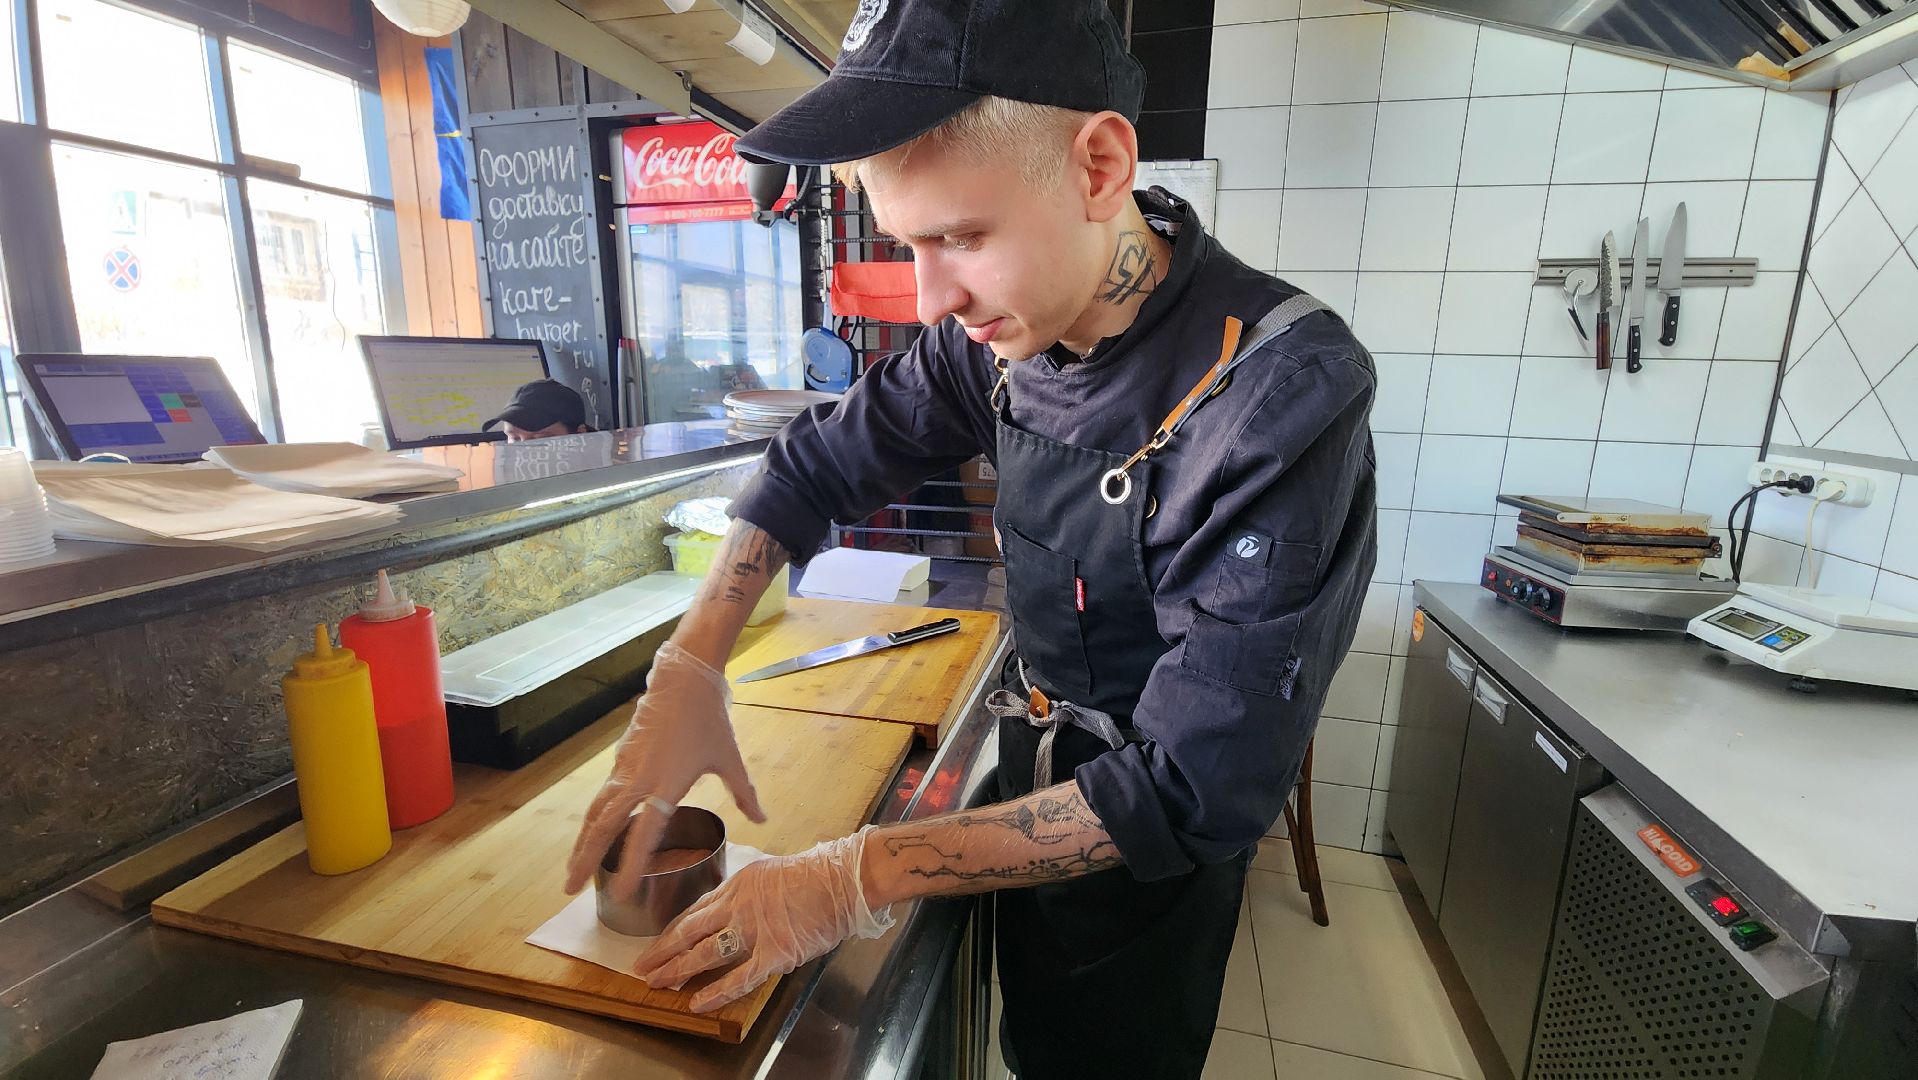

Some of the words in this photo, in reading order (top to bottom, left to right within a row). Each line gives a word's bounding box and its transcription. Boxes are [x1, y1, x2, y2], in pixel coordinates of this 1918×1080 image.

[480, 145, 576, 188] ОФОРМИ
[488, 186, 585, 239] доставку
[486, 240, 520, 272] на
[521, 223, 587, 269] сайте
